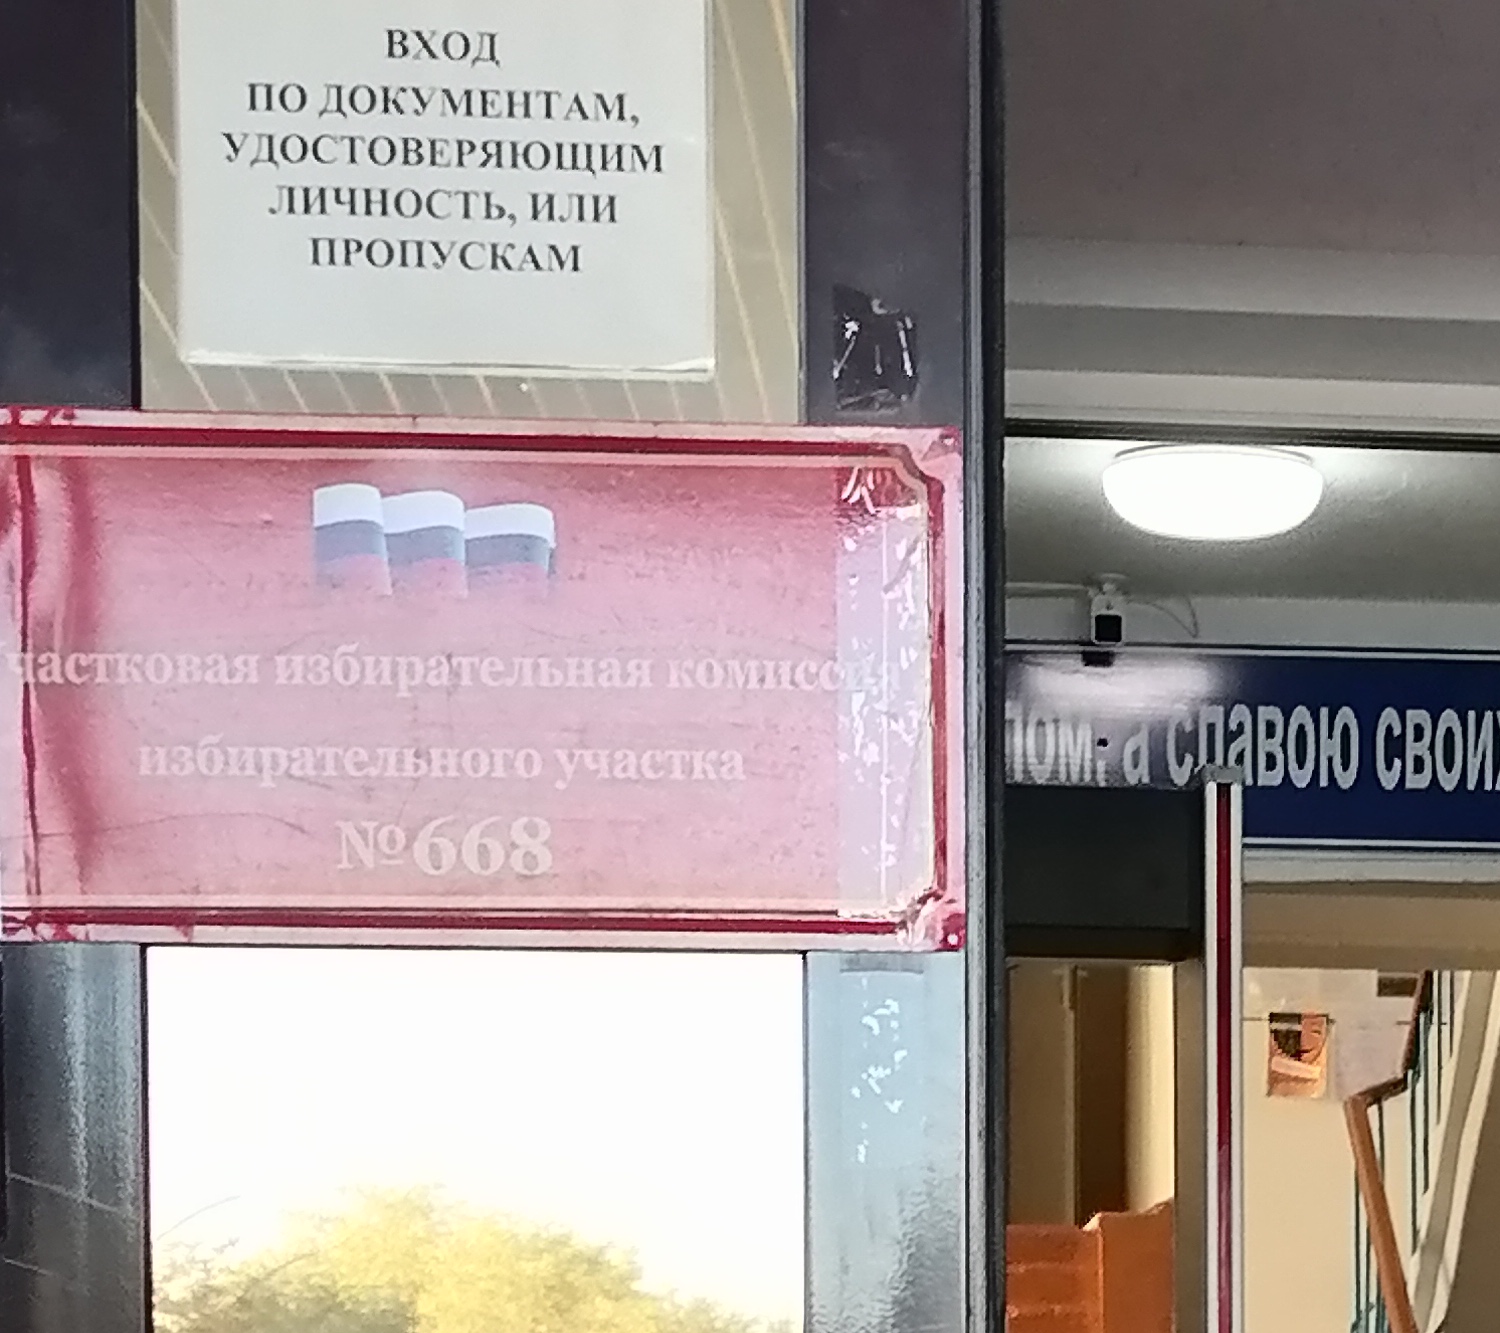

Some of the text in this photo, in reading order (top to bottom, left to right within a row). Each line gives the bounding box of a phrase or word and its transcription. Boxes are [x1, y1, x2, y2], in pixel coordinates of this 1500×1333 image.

[385, 28, 500, 66] ВХОД
[246, 82, 640, 128] ПО ДОКУМЕНТАМ,
[220, 132, 665, 178] УДОСТОВЕРЯЮЩИМ
[267, 185, 619, 225] ЛИЧНОСТЬ, ИЛИ
[308, 237, 583, 273] ПРОПУСКАМ
[0, 642, 260, 685] частковая
[276, 647, 652, 696] избирательная
[138, 736, 745, 791] избирательного участка
[1123, 712, 1150, 787] а
[1166, 703, 1360, 790] славою
[336, 817, 554, 877] №668
